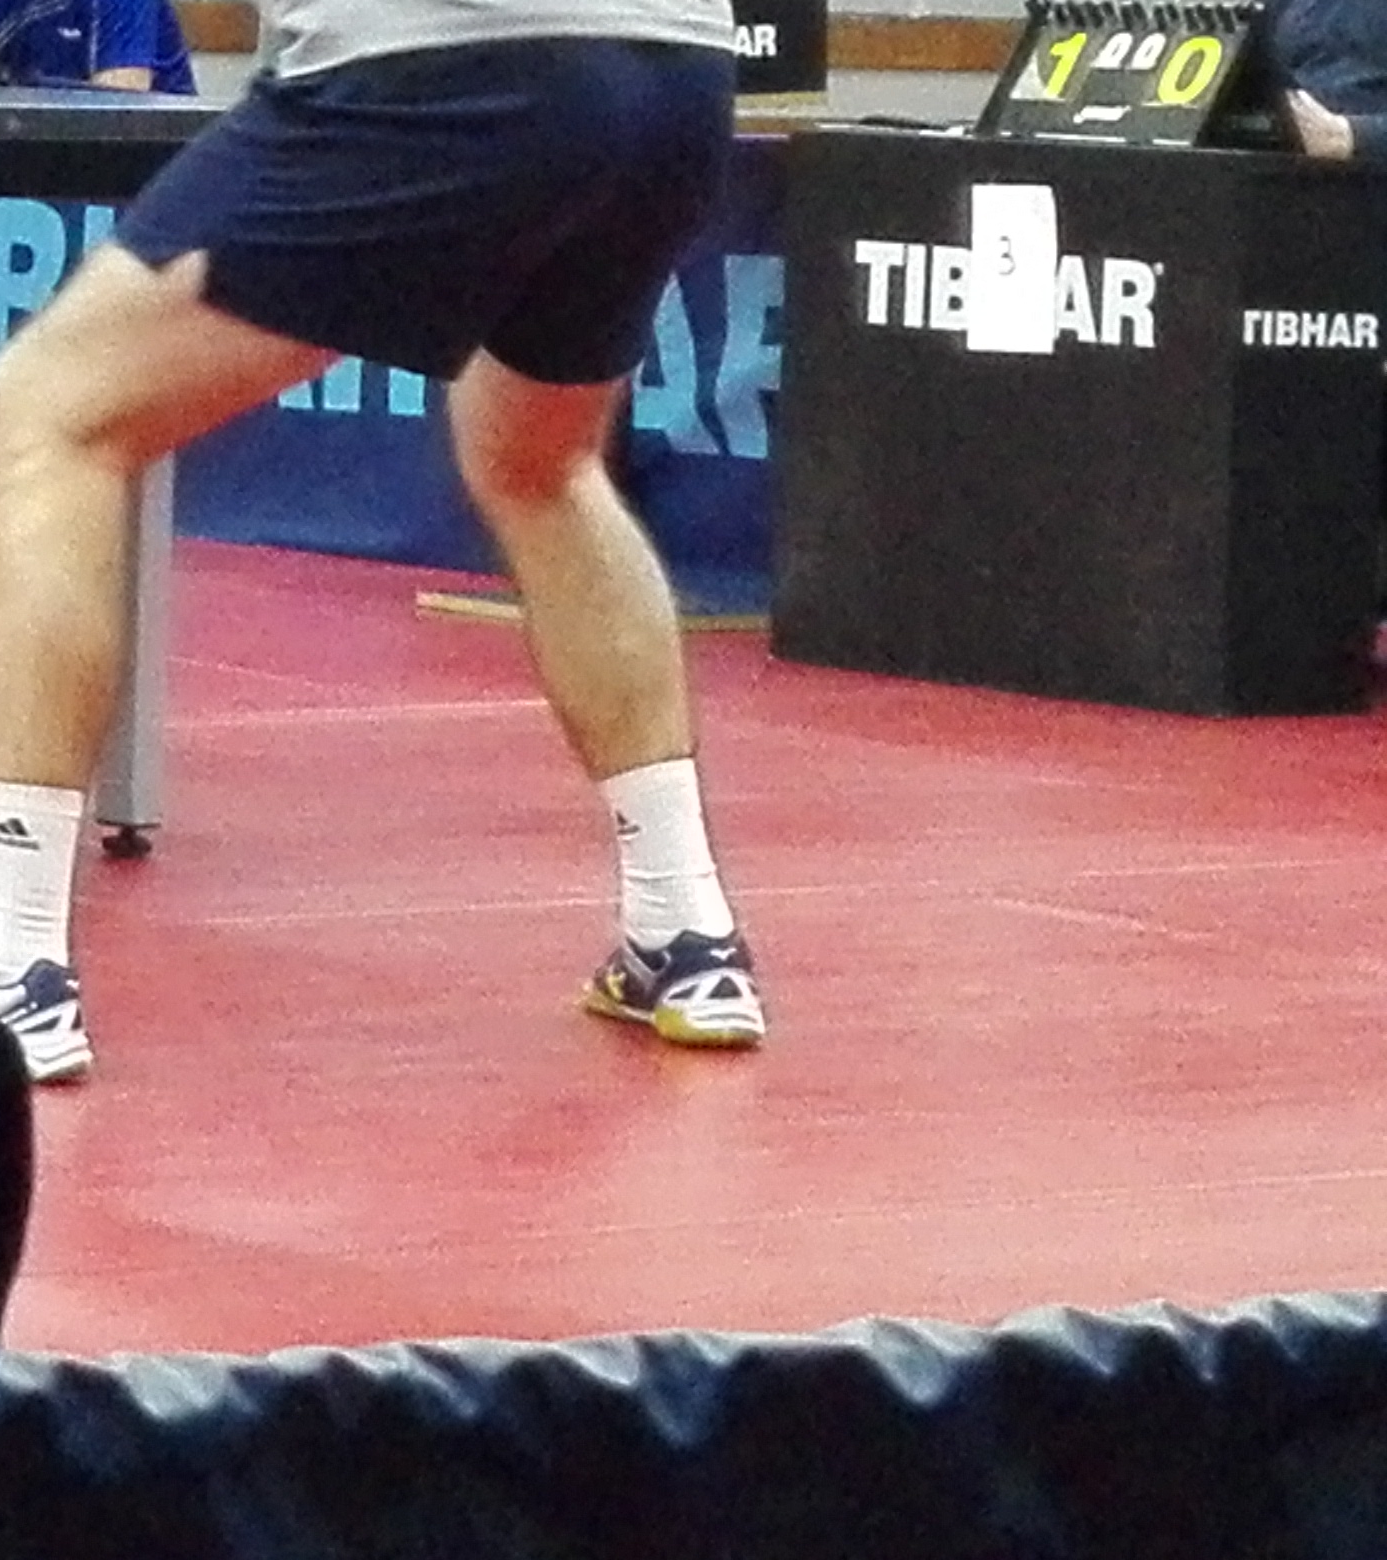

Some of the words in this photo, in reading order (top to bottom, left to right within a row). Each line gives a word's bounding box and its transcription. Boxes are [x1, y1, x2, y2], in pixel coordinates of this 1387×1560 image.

[1045, 32, 1087, 97] 1
[1157, 36, 1223, 105] 0
[997, 235, 1016, 276] 3
[855, 239, 1159, 349] TIBAR
[1242, 309, 1380, 348] TIBHAR
